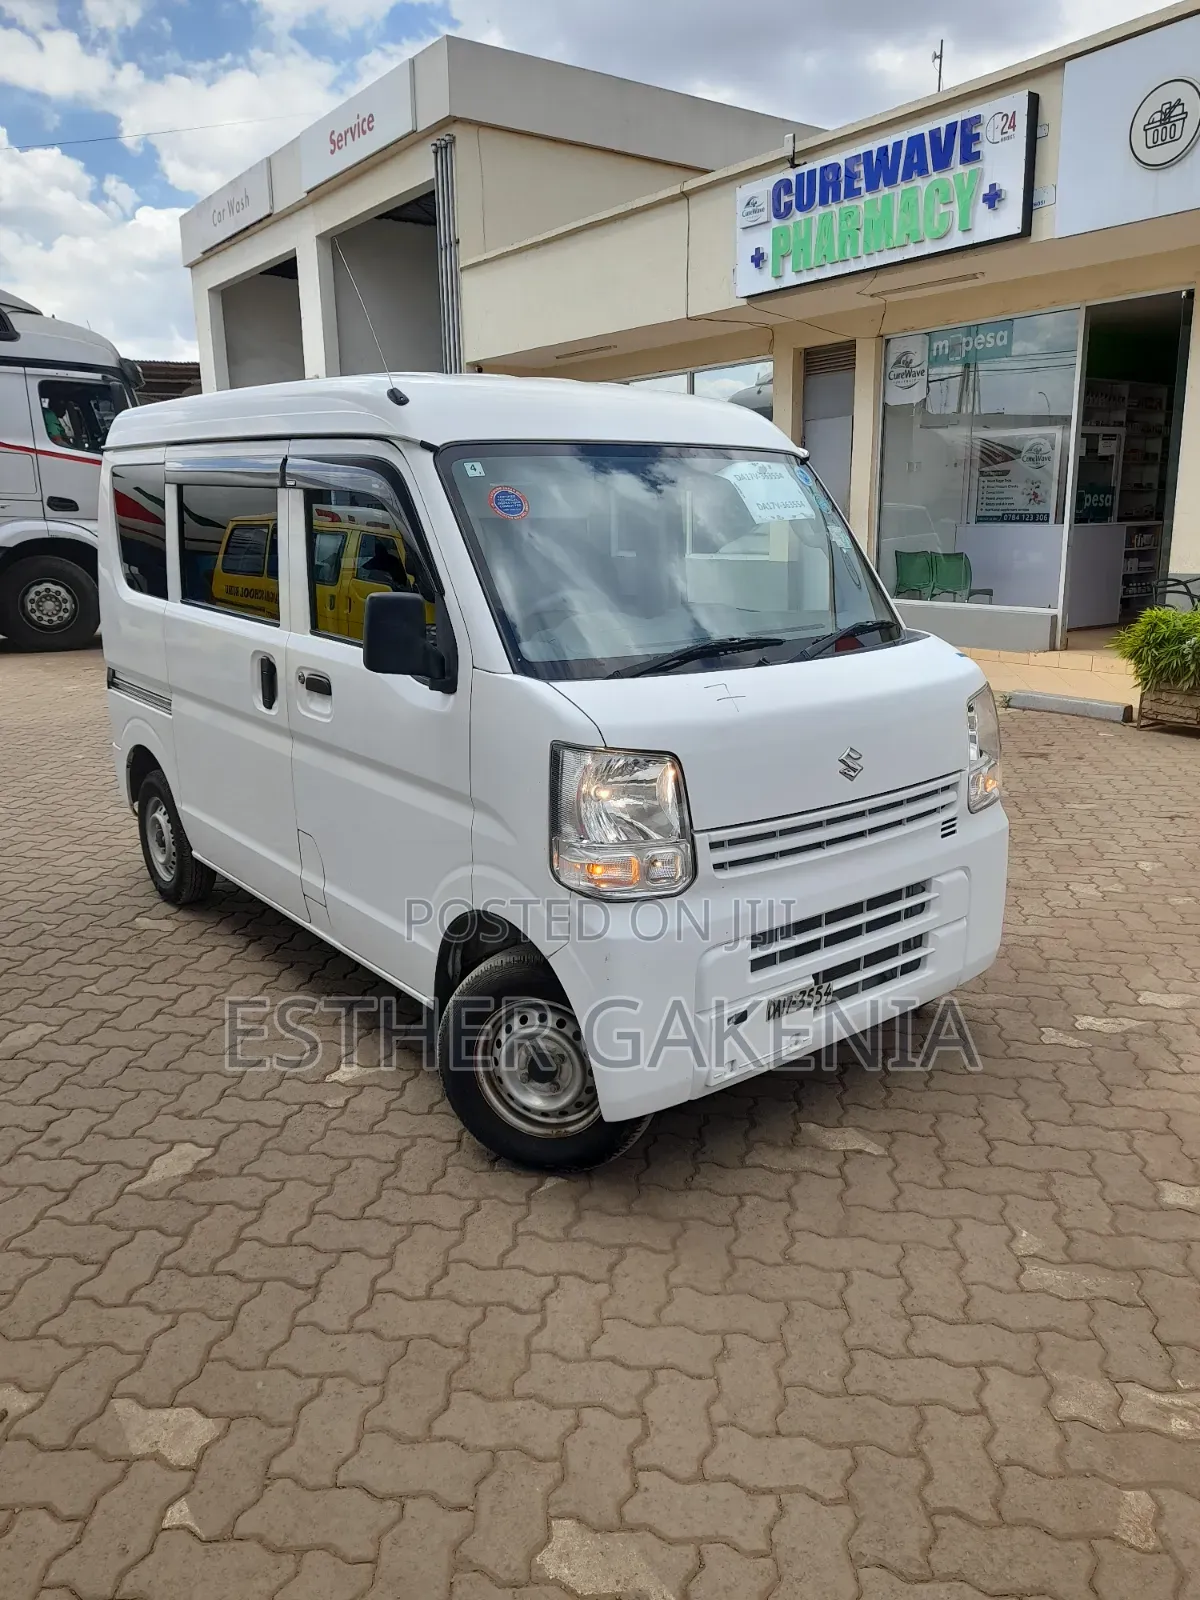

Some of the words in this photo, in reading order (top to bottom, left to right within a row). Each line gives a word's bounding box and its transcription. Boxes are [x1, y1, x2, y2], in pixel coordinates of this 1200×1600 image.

[329, 112, 375, 155] Service
[1000, 110, 1017, 136] 24
[771, 114, 983, 220] CUREWAVE
[211, 208, 226, 227] Car
[227, 188, 250, 218] Wash
[771, 167, 982, 279] PHARMACY
[888, 367, 925, 381] CureWave
[1003, 513, 1020, 521] 0784
[1022, 513, 1034, 521] 123
[1035, 513, 1048, 521] 306
